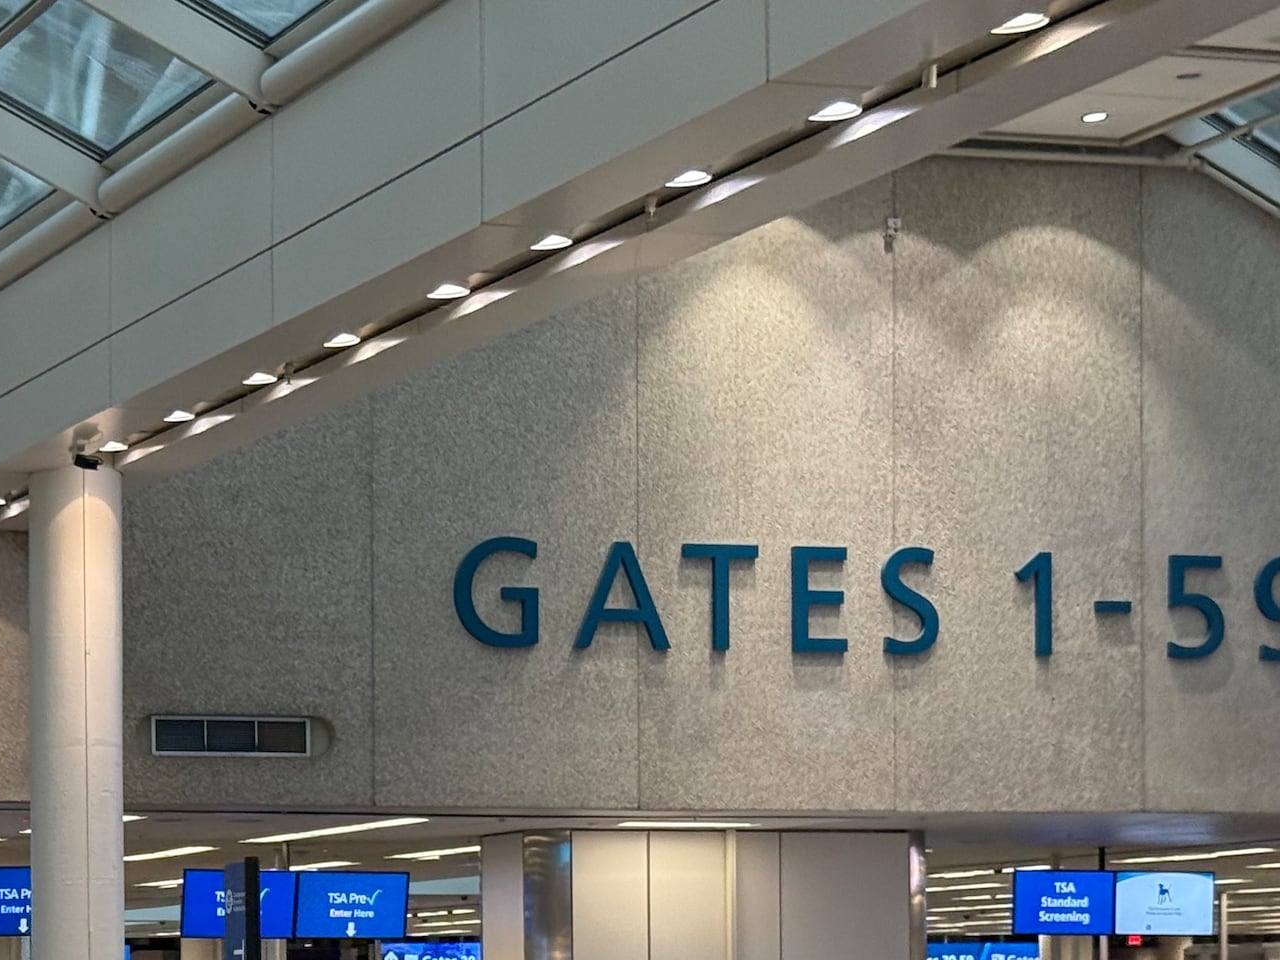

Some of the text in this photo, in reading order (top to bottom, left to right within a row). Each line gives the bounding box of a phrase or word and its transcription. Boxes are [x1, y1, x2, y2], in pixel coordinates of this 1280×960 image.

[452, 536, 941, 656] GATES
[1054, 881, 1076, 894] TSA
[328, 892, 367, 904] TSA Pre
[1040, 896, 1089, 908] Standard
[1, 905, 24, 914] Enter
[329, 908, 374, 918] Enter Here
[1038, 910, 1090, 924] Screening
